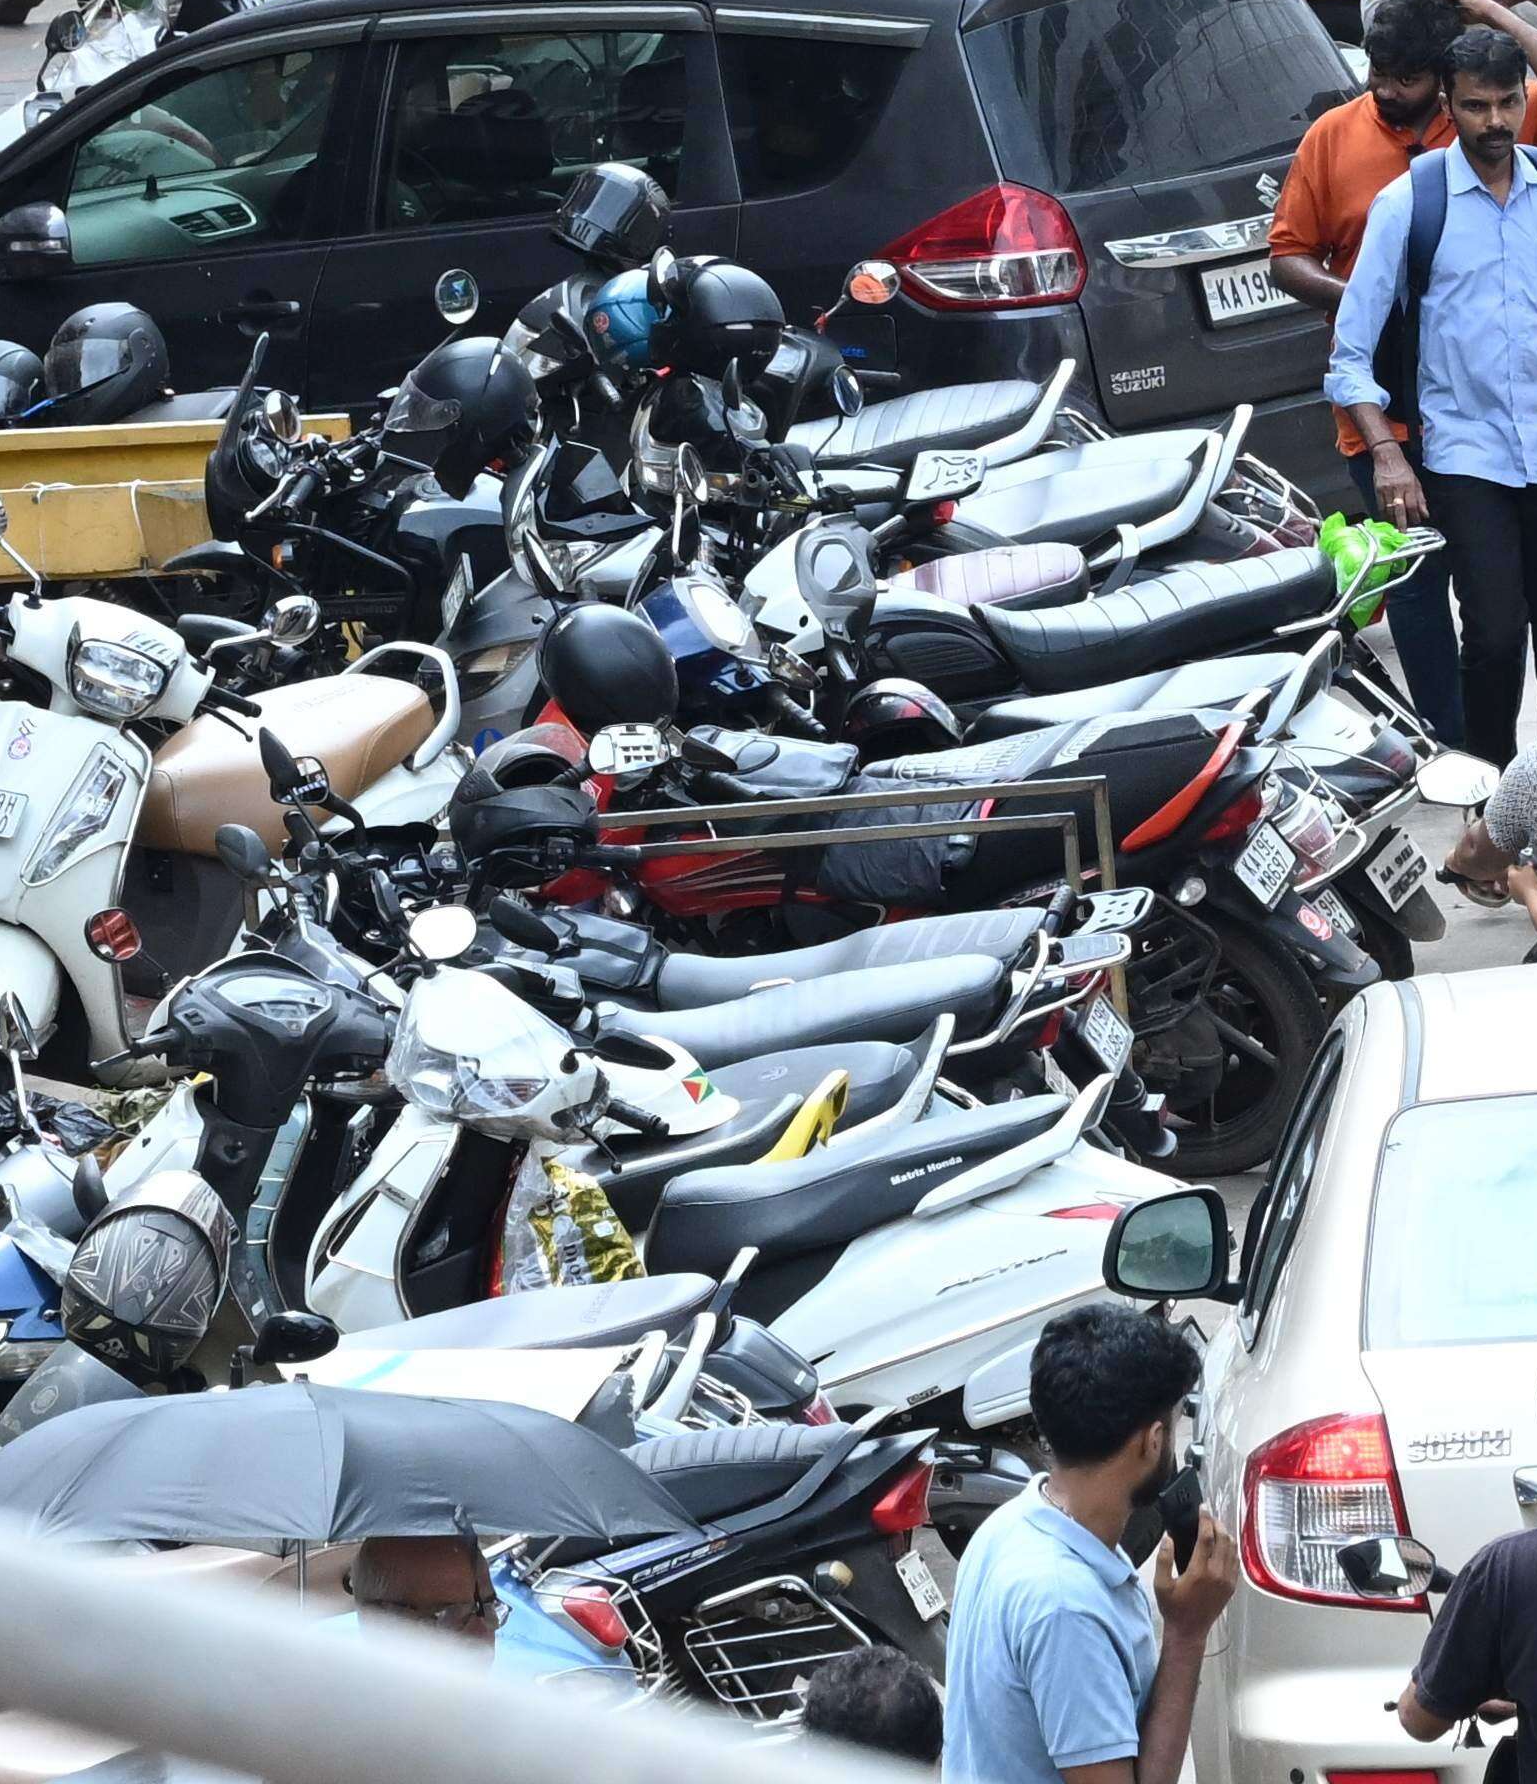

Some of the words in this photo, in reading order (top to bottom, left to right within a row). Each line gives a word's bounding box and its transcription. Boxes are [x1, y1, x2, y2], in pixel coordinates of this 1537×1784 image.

[1110, 365, 1165, 383] MARUTI
[1111, 376, 1166, 395] SUZUKI
[890, 1163, 926, 1187] Matrix
[927, 1155, 965, 1178] Honda
[1406, 1439, 1512, 1464] SUZUKI
